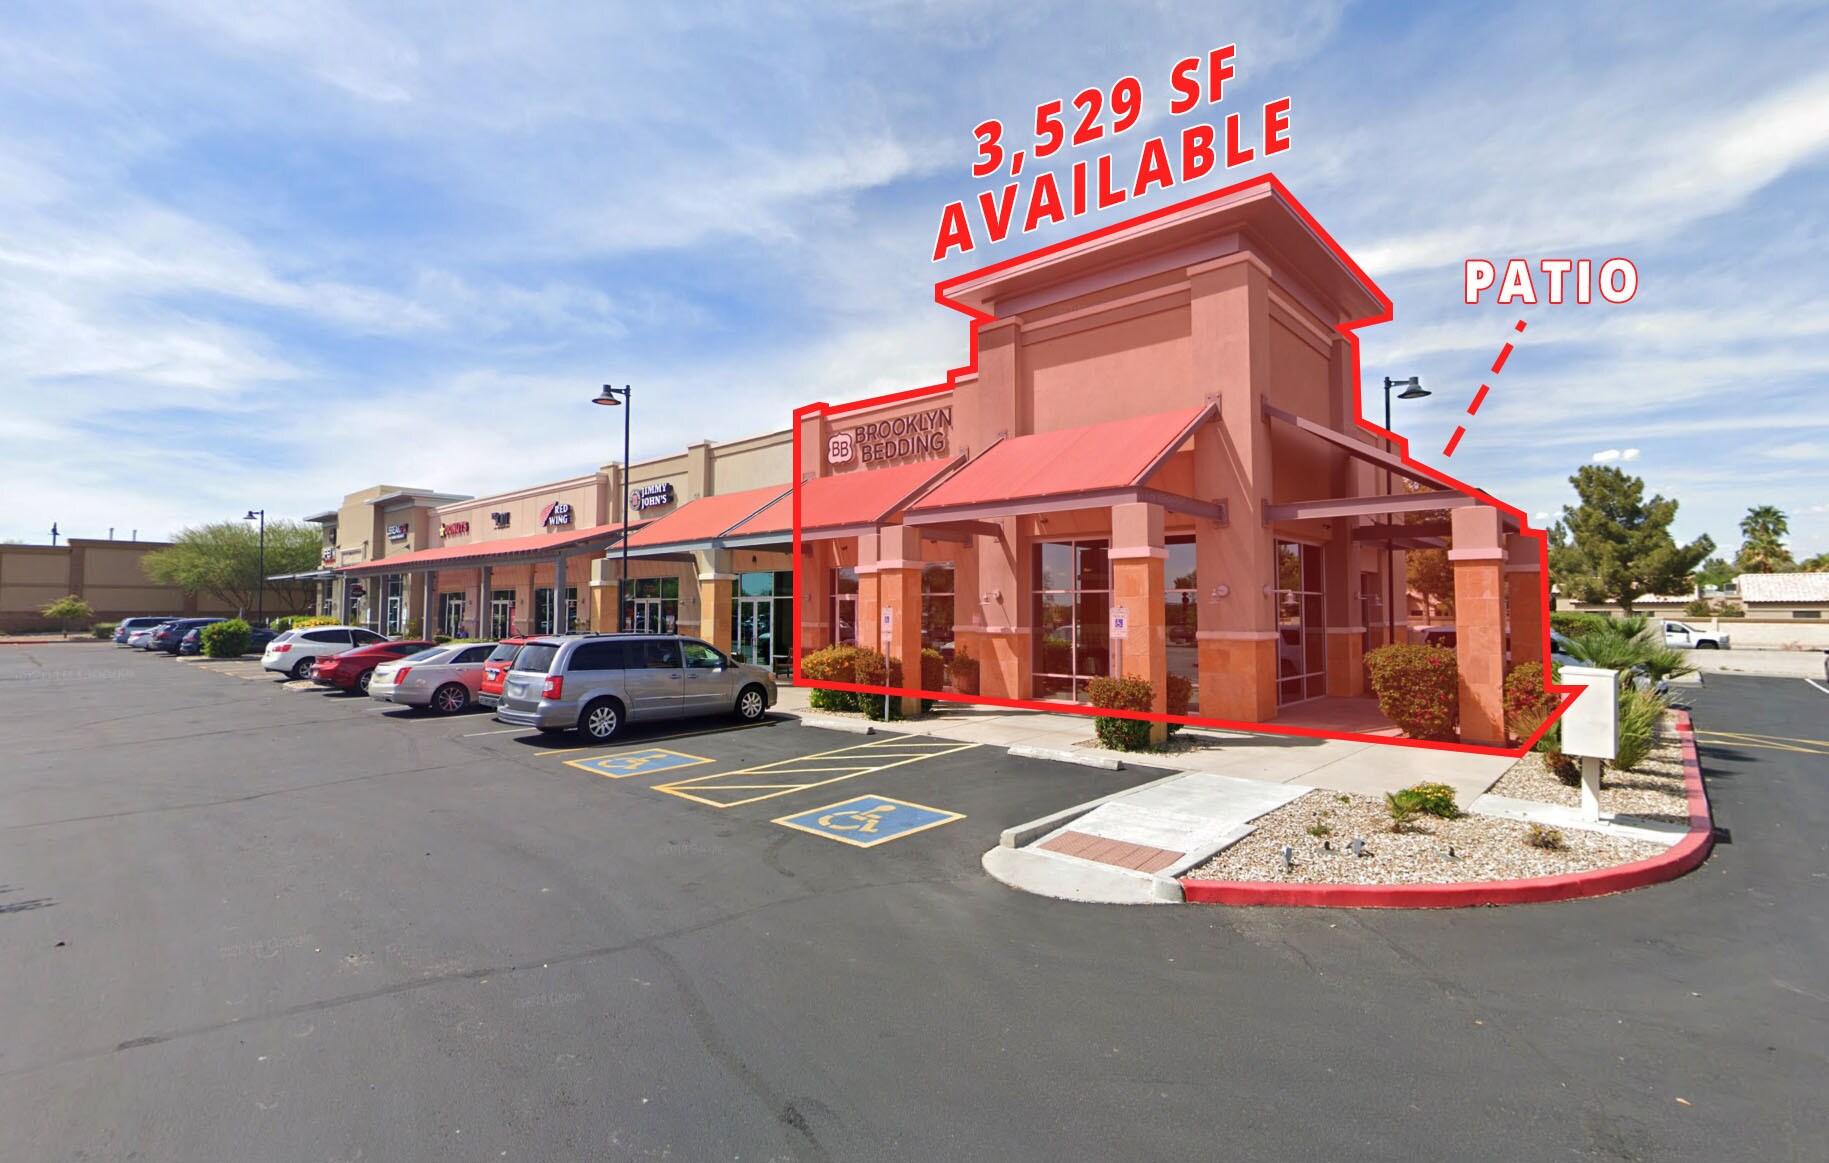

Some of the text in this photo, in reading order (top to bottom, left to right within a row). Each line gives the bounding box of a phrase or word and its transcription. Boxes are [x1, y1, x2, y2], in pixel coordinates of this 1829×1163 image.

[855, 408, 952, 444] BROOKLYN
[832, 441, 849, 457] BB
[862, 431, 945, 463] BEDDING
[641, 483, 667, 497] JIMMY
[554, 504, 569, 514] RED
[641, 494, 667, 509] JOHN'S
[548, 515, 568, 525] WING
